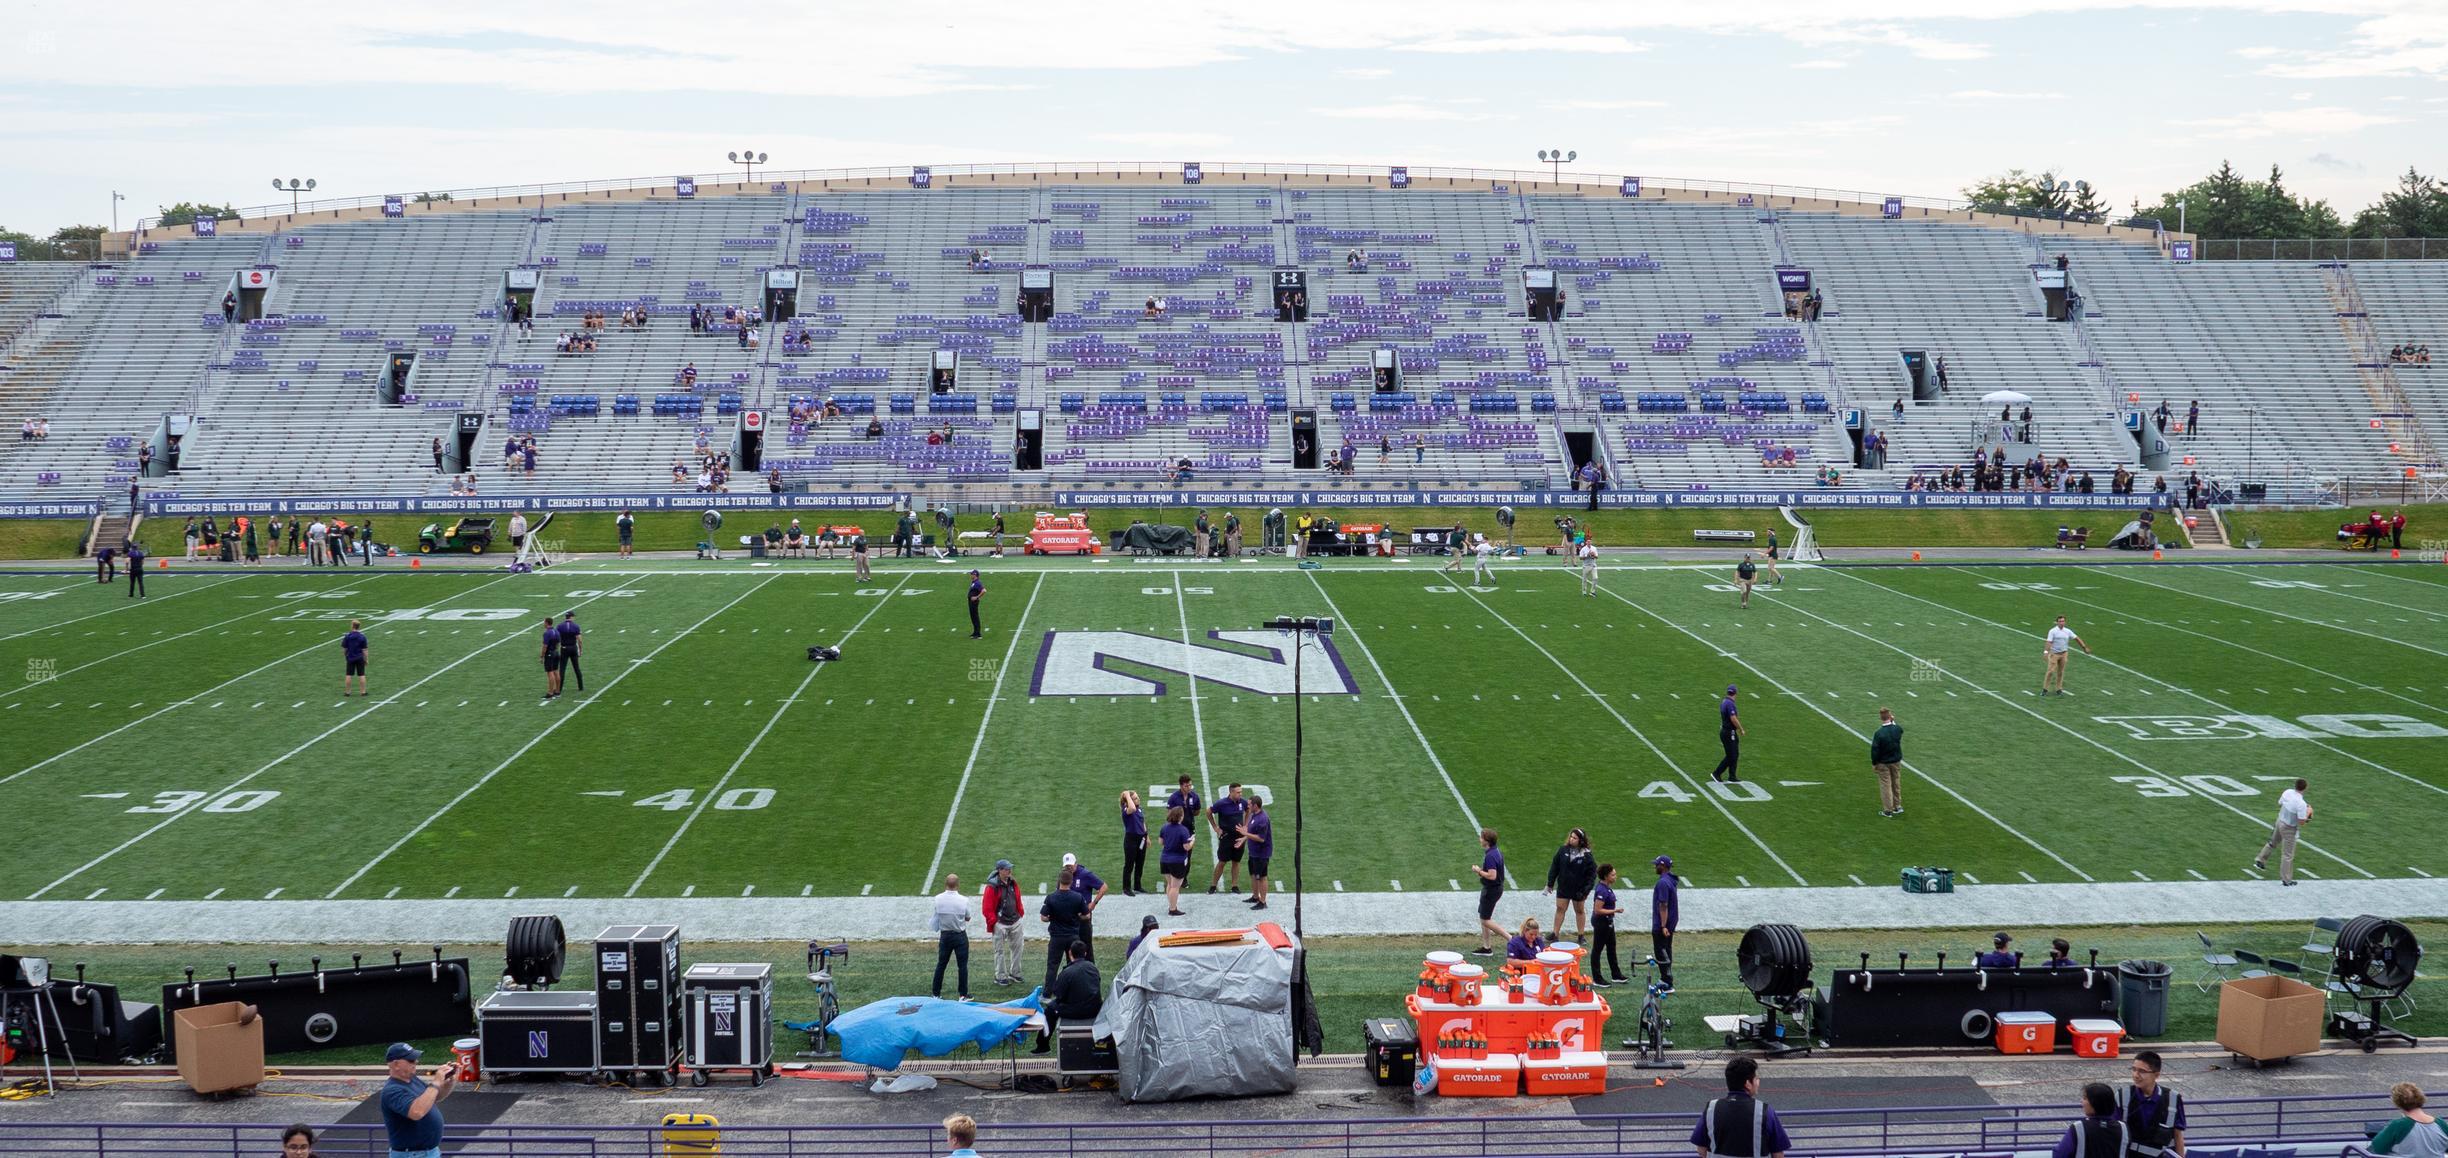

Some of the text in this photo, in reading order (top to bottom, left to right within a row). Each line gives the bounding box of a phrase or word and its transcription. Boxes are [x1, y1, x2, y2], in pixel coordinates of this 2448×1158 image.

[915, 173, 929, 183] 107
[1185, 169, 1199, 179] 108
[1392, 173, 1406, 183] 109
[678, 184, 692, 193] 106
[1625, 183, 1637, 192] 110
[387, 203, 402, 212] 105
[1888, 204, 1899, 214] 111
[197, 222, 214, 232] 104
[2175, 248, 2189, 258] 112
[149, 503, 158, 513] N
[165, 504, 211, 512] CHICAGO'S
[211, 503, 227, 511] BIG
[227, 503, 246, 511] TEN
[246, 503, 272, 511] TEAM
[279, 502, 288, 511] N
[294, 502, 340, 510] CHICAGO'S
[339, 501, 356, 509] BIG
[355, 501, 375, 509] TEN
[374, 501, 400, 509] TEAM
[406, 500, 415, 510] N
[421, 500, 466, 508] CHICAGO'S
[466, 500, 482, 508] BIG
[482, 500, 501, 508] TEN
[500, 500, 526, 508] TEAM
[532, 498, 541, 508] N
[547, 499, 591, 507] CHICAGO'S
[591, 498, 607, 506] BIG
[607, 498, 625, 506] TEN
[625, 498, 650, 506] TEAM
[656, 497, 665, 506] N
[671, 498, 715, 506] CHICAGO'S
[730, 497, 748, 505] TEN
[748, 497, 772, 505] TEAM
[779, 496, 788, 505] N
[794, 497, 837, 505] CHICAGO'S
[837, 497, 852, 505] BIG
[1059, 494, 1067, 503] N
[1074, 495, 1117, 503] CHICAGO'S
[1117, 495, 1132, 503] BIG
[1132, 495, 1150, 503] TEN
[1180, 493, 1189, 503] N
[1195, 494, 1238, 502] CHICAGO'S
[1238, 494, 1253, 502] BIG
[1253, 494, 1271, 502] TEN
[1301, 494, 1310, 503] N
[1422, 494, 1431, 503] N
[1437, 494, 1480, 502] CHICAGO'S
[1543, 494, 1552, 503] N
[1665, 494, 1673, 503] N
[1755, 495, 1780, 503] TEAM
[1787, 494, 1795, 503] N
[1802, 495, 1845, 503] CHICAGO'S
[1845, 495, 1860, 503] BIG
[1860, 495, 1878, 503] TEN
[1878, 495, 1903, 503] TEAM
[1909, 495, 1918, 504] N
[1925, 496, 1968, 504] CHICAGO'S
[1968, 496, 1984, 504] BIG
[1983, 496, 2002, 504] TEN
[2001, 496, 2026, 504] TEAM
[2033, 495, 2042, 505] N
[2049, 496, 2092, 504] CHICAGO'S
[2093, 496, 2108, 504] BIG
[2127, 497, 2151, 505] TEAM
[2158, 496, 2167, 505] N
[24, 506, 41, 514] BIG
[41, 506, 60, 514] TEN
[60, 505, 87, 514] TEAM
[1041, 537, 1080, 545] GATORADE
[1029, 629, 1361, 697] N
[1636, 781, 1774, 803] 40
[2109, 775, 2261, 798] 30
[124, 790, 283, 814] 30
[632, 788, 778, 812] 40
[1147, 784, 1275, 808] 50
[1548, 969, 1564, 986] G
[1465, 981, 1476, 993] G
[1551, 1018, 1585, 1052] G
[2023, 1026, 2036, 1041] G
[529, 1030, 548, 1058] N
[2092, 1037, 2108, 1054] G
[462, 1055, 471, 1067] G
[1453, 1073, 1503, 1083] GATORADE
